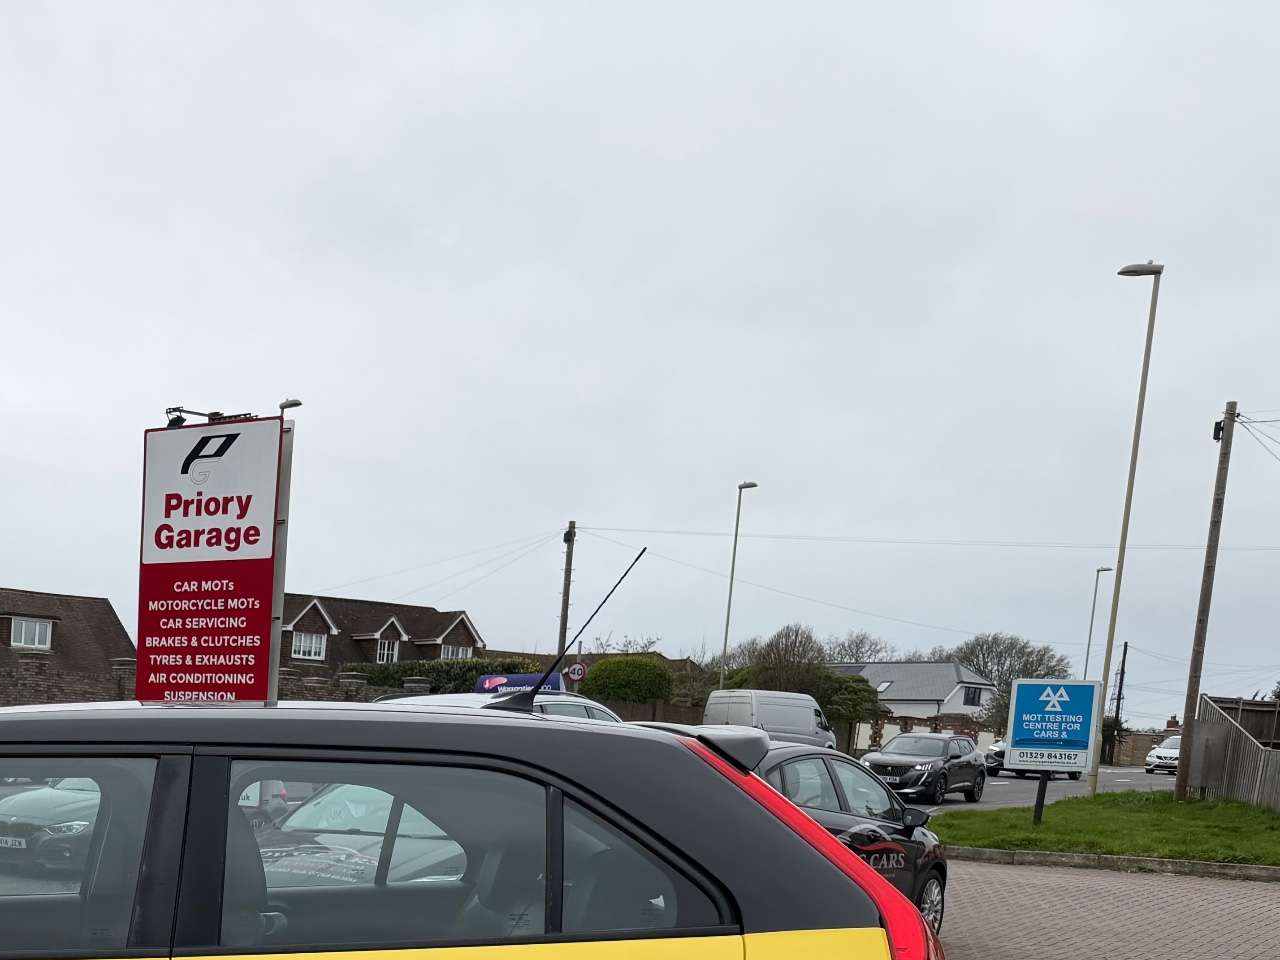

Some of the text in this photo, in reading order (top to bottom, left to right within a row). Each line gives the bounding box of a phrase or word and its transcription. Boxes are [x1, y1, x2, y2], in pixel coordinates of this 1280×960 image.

[164, 491, 253, 520] Priory
[154, 523, 261, 551] Garage
[173, 580, 234, 593] CAR MOTs
[148, 598, 261, 612] MOTORCYCLE MOTs
[159, 617, 247, 629] CAR SERVICING
[145, 635, 261, 648] BRAKES & CLUTCHES
[150, 654, 255, 665] TYRES & EXHAUSTS
[570, 667, 583, 676] 40
[148, 673, 255, 685] AIR CONDITIONING
[164, 690, 236, 701] SUSPENSION
[1044, 714, 1083, 722] TESTING
[1023, 722, 1059, 730] CENTRE
[1019, 751, 1078, 760] 01329 843167
[870, 853, 905, 869] CARS
